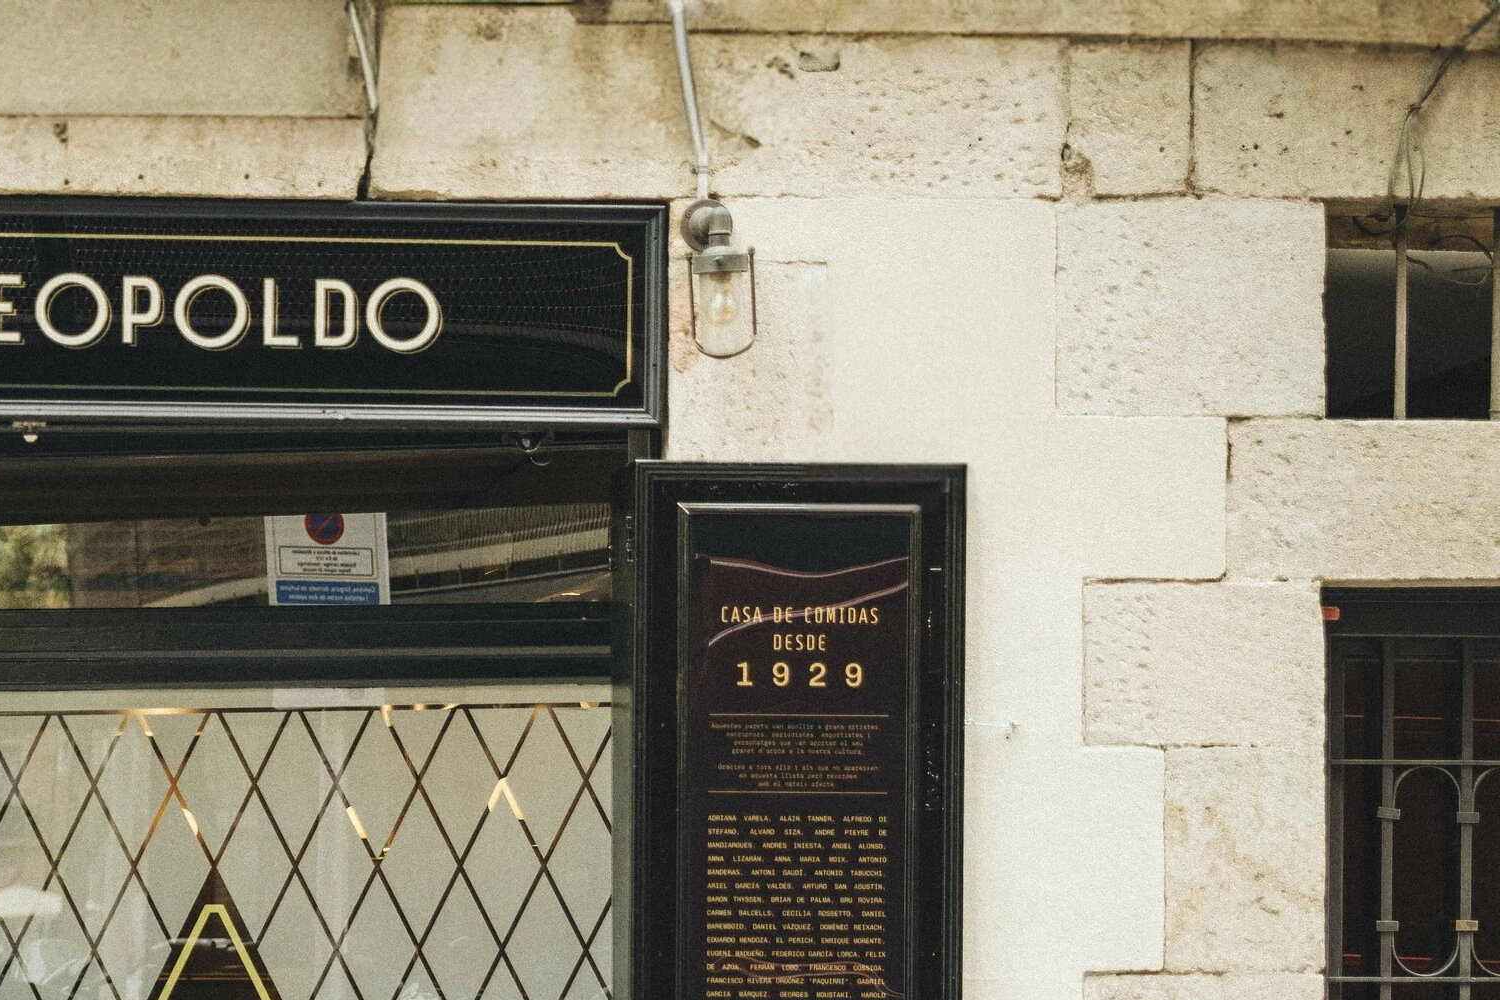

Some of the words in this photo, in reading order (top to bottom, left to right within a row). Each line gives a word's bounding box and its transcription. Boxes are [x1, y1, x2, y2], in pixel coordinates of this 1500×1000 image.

[721, 606, 763, 623] CASA
[773, 606, 793, 624] DE
[804, 607, 879, 625] COMIDAS
[773, 634, 826, 651] DESDE
